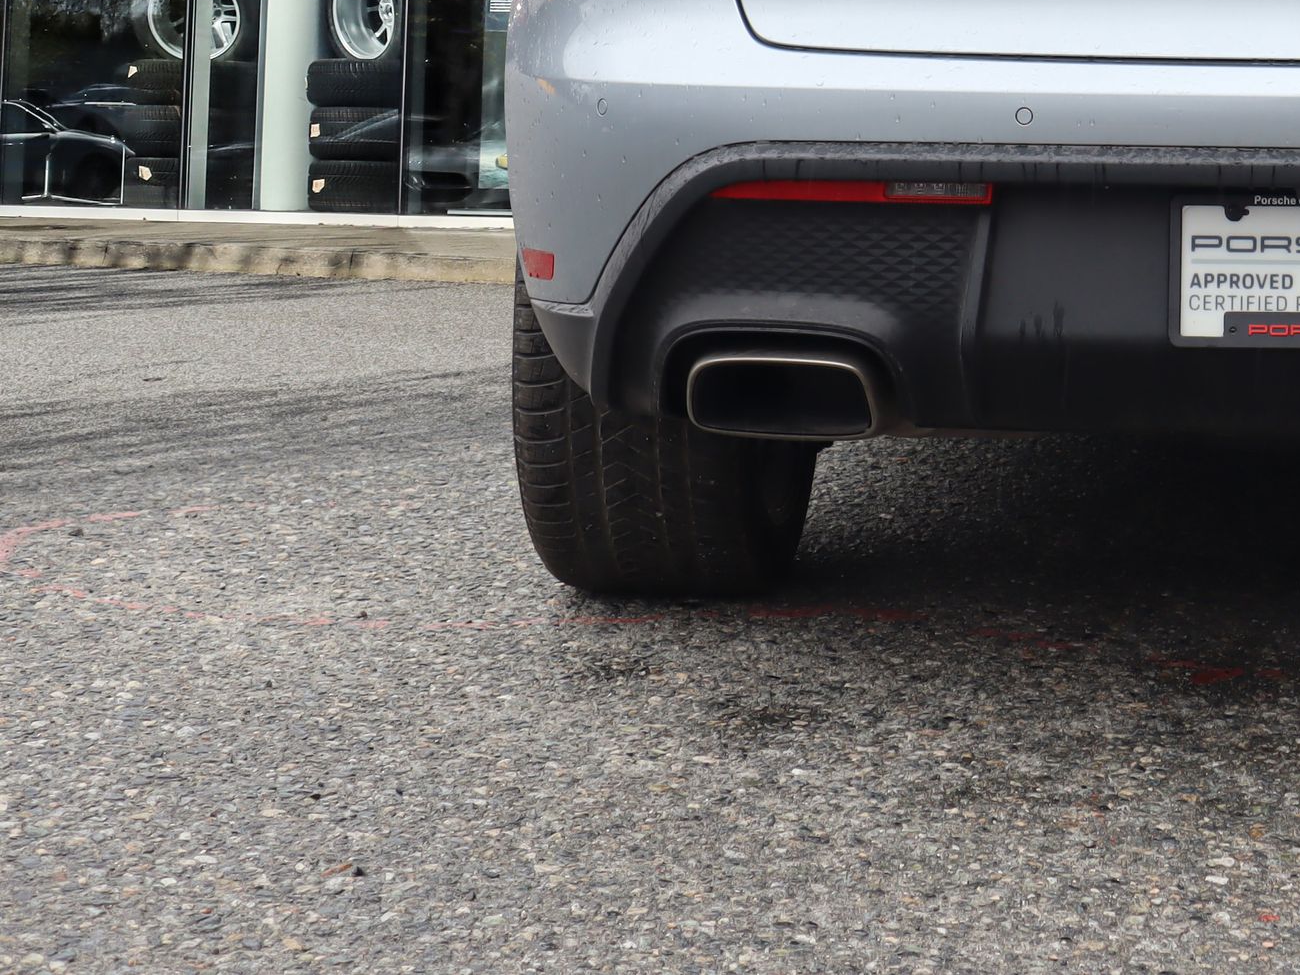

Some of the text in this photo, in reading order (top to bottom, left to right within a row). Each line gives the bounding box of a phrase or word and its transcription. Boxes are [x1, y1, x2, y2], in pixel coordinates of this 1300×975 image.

[1254, 195, 1296, 205] Porsche
[1190, 273, 1294, 290] APPROVED
[1188, 294, 1288, 312] CERTIFIED
